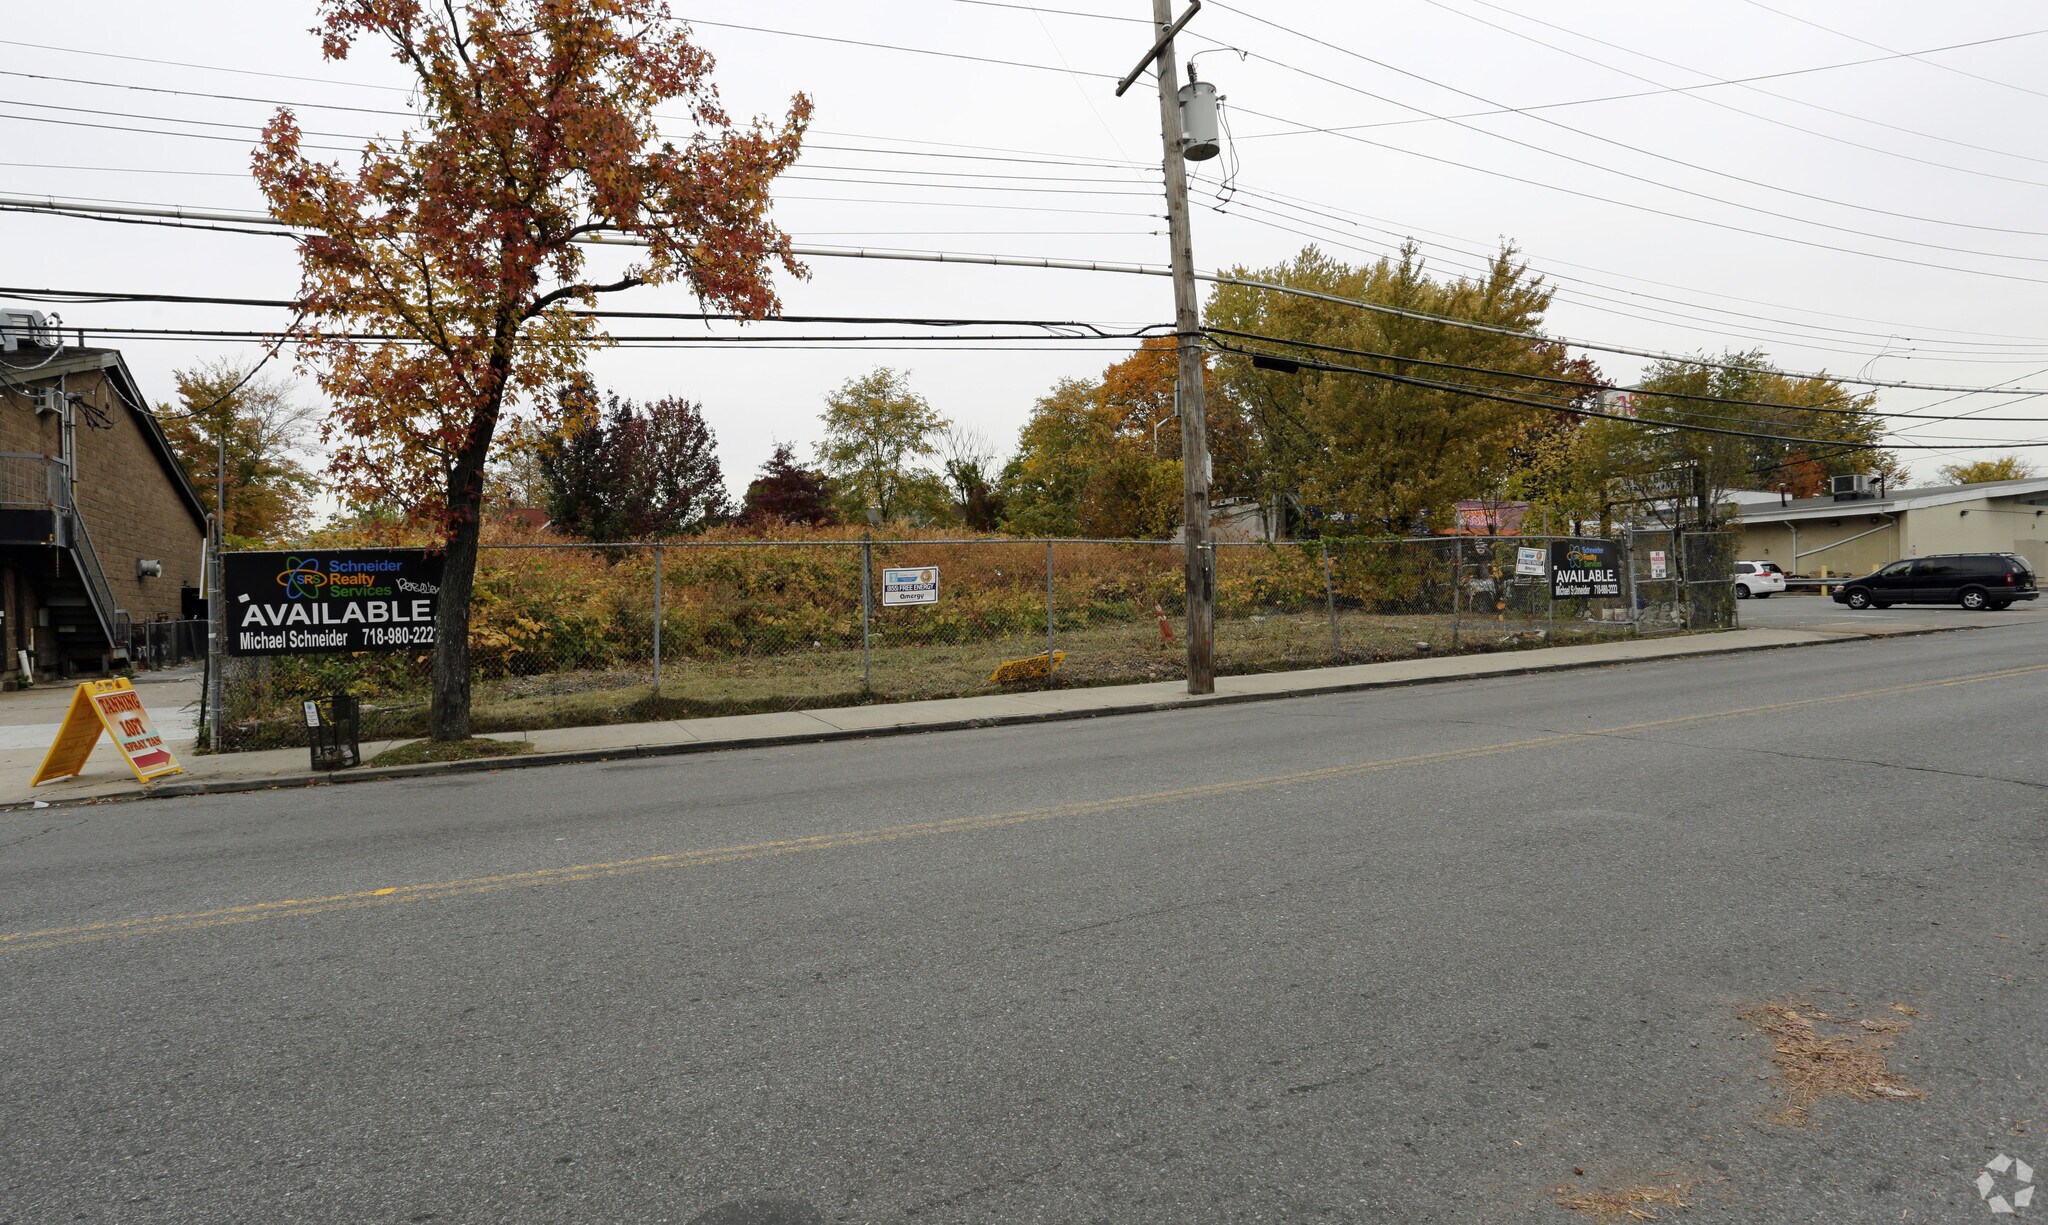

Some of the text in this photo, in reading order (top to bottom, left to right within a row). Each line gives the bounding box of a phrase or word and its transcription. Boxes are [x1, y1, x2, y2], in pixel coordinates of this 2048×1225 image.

[329, 560, 403, 572] Schneider
[296, 574, 321, 585] SRS
[329, 573, 375, 587] Realty
[1556, 569, 1617, 583] AVAILABLE.
[330, 585, 392, 597] Services
[240, 626, 437, 650] Michael Schneider 718-980-222
[98, 693, 140, 714] TANNING
[119, 717, 147, 738] LOFT
[124, 736, 162, 752] SPRAY TAN
